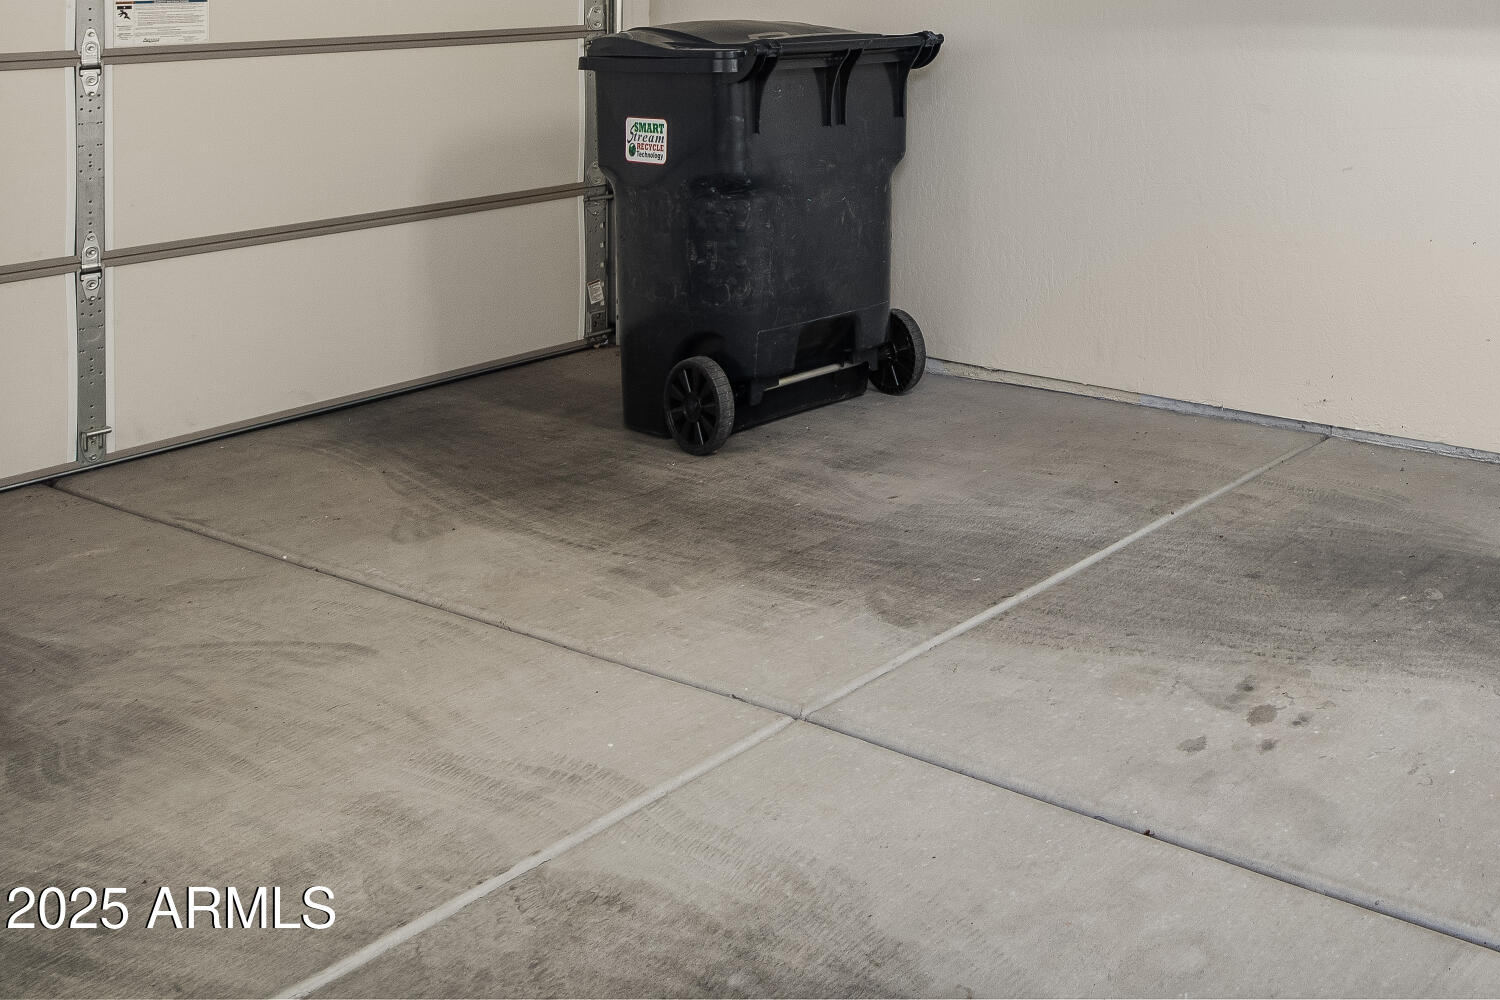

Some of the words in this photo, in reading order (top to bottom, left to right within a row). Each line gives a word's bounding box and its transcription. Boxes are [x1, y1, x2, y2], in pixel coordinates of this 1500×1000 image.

[634, 121, 665, 134] SMART
[627, 124, 665, 144] Stream
[636, 142, 664, 152] RECYCLE
[636, 150, 664, 161] Technology
